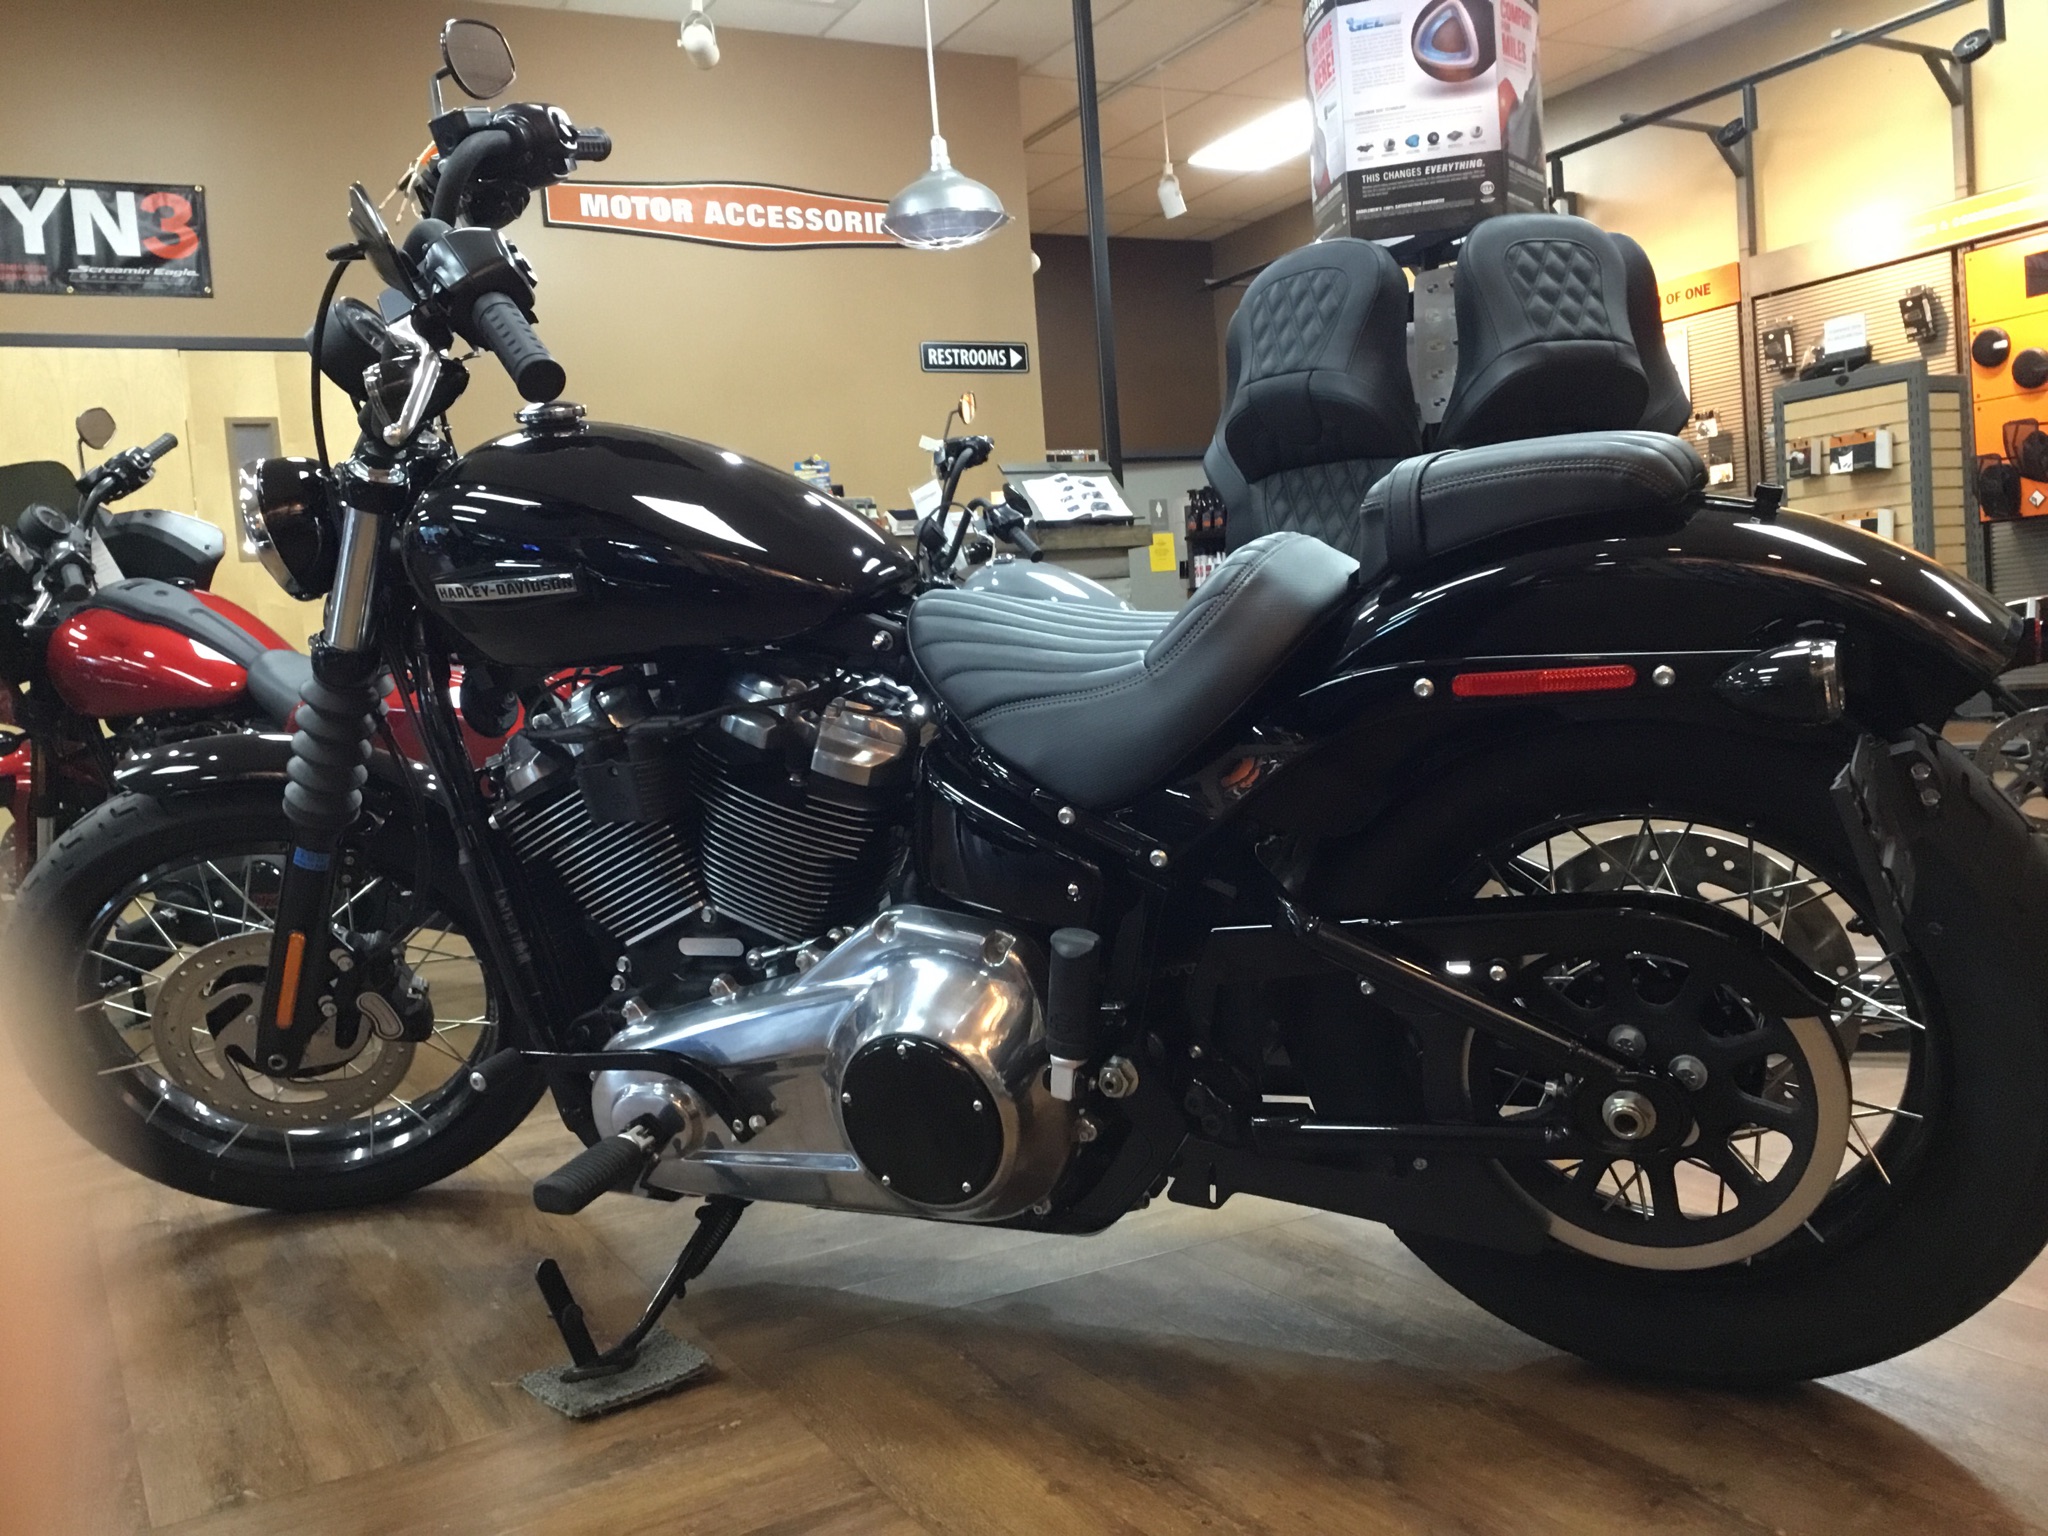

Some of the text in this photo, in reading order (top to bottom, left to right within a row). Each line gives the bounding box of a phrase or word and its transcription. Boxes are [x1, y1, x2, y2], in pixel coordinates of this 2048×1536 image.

[1362, 158, 1486, 183] THIS CHANGES EVERYTHING.
[579, 192, 887, 235] MOTOR ACCESSORIE
[154, 267, 199, 278] Eagle
[1666, 283, 1711, 305] OF ONE
[928, 348, 1007, 366] RESTROOMS
[438, 578, 574, 600] HARLEY-DAVIDSON
